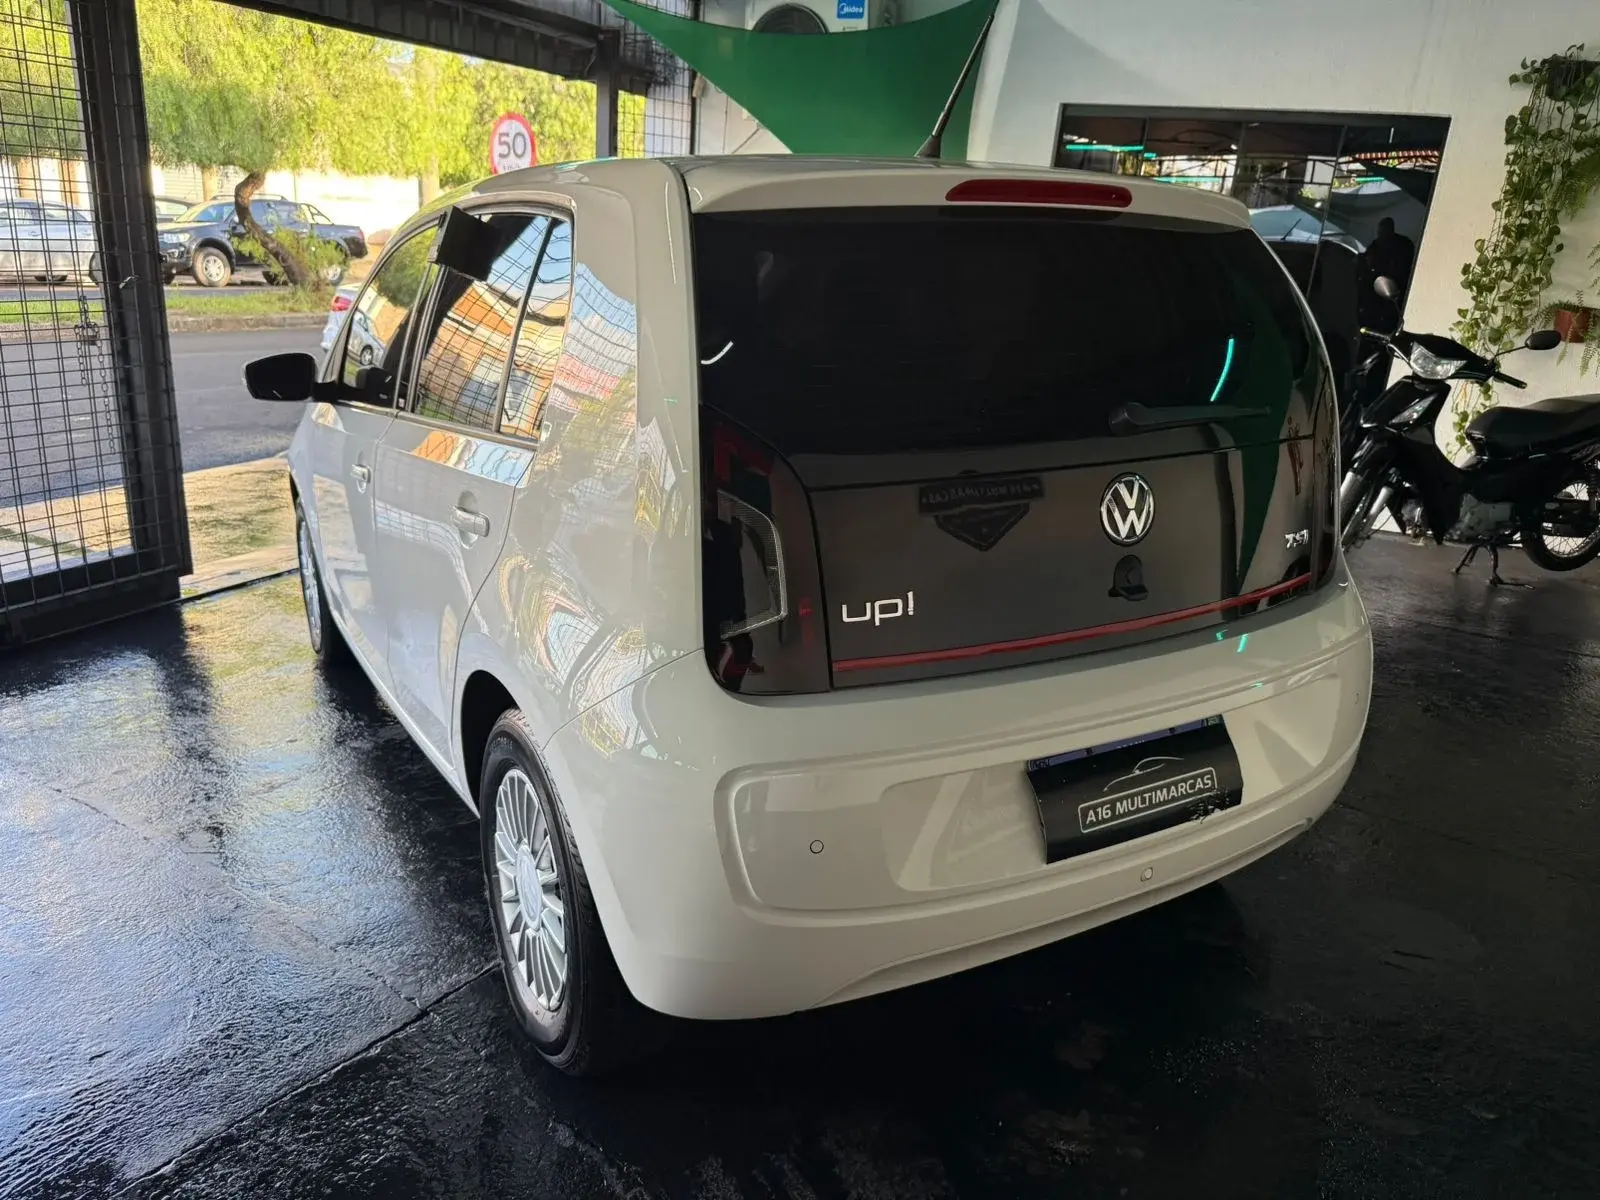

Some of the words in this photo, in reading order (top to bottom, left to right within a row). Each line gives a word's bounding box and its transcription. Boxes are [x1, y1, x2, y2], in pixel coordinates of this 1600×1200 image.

[498, 131, 527, 159] 50
[1103, 477, 1152, 540] VW
[841, 591, 914, 627] up!
[1085, 804, 1112, 825] A16
[1115, 774, 1213, 816] MULTIMARCAS
